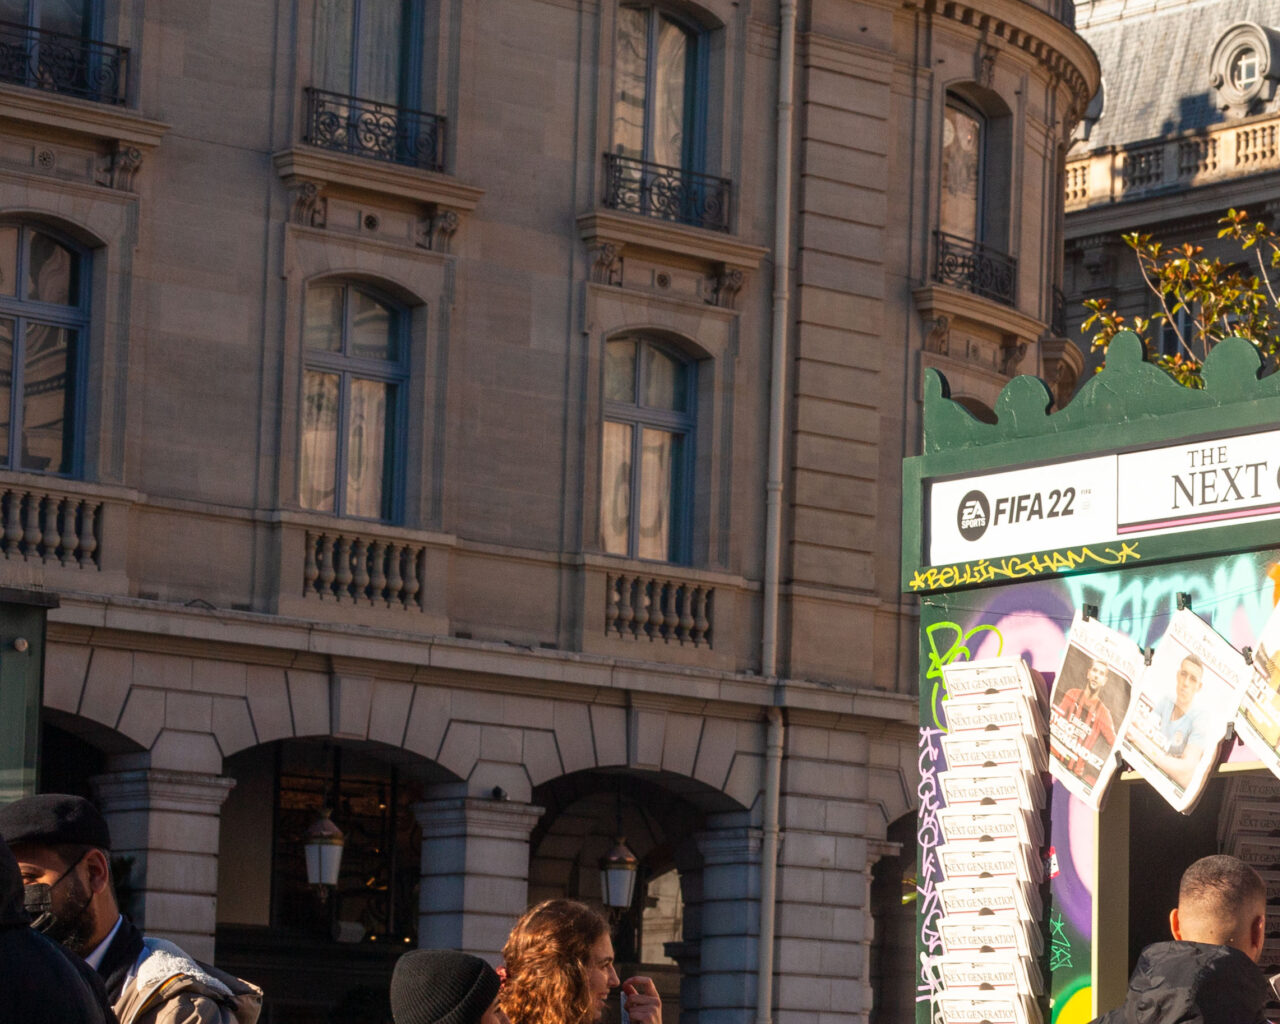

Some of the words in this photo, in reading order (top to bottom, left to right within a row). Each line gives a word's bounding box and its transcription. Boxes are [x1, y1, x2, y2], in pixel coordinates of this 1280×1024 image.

[1187, 445, 1228, 468] THE
[1171, 462, 1268, 509] NEXT
[961, 502, 985, 519] EA
[961, 517, 986, 529] SPORTS
